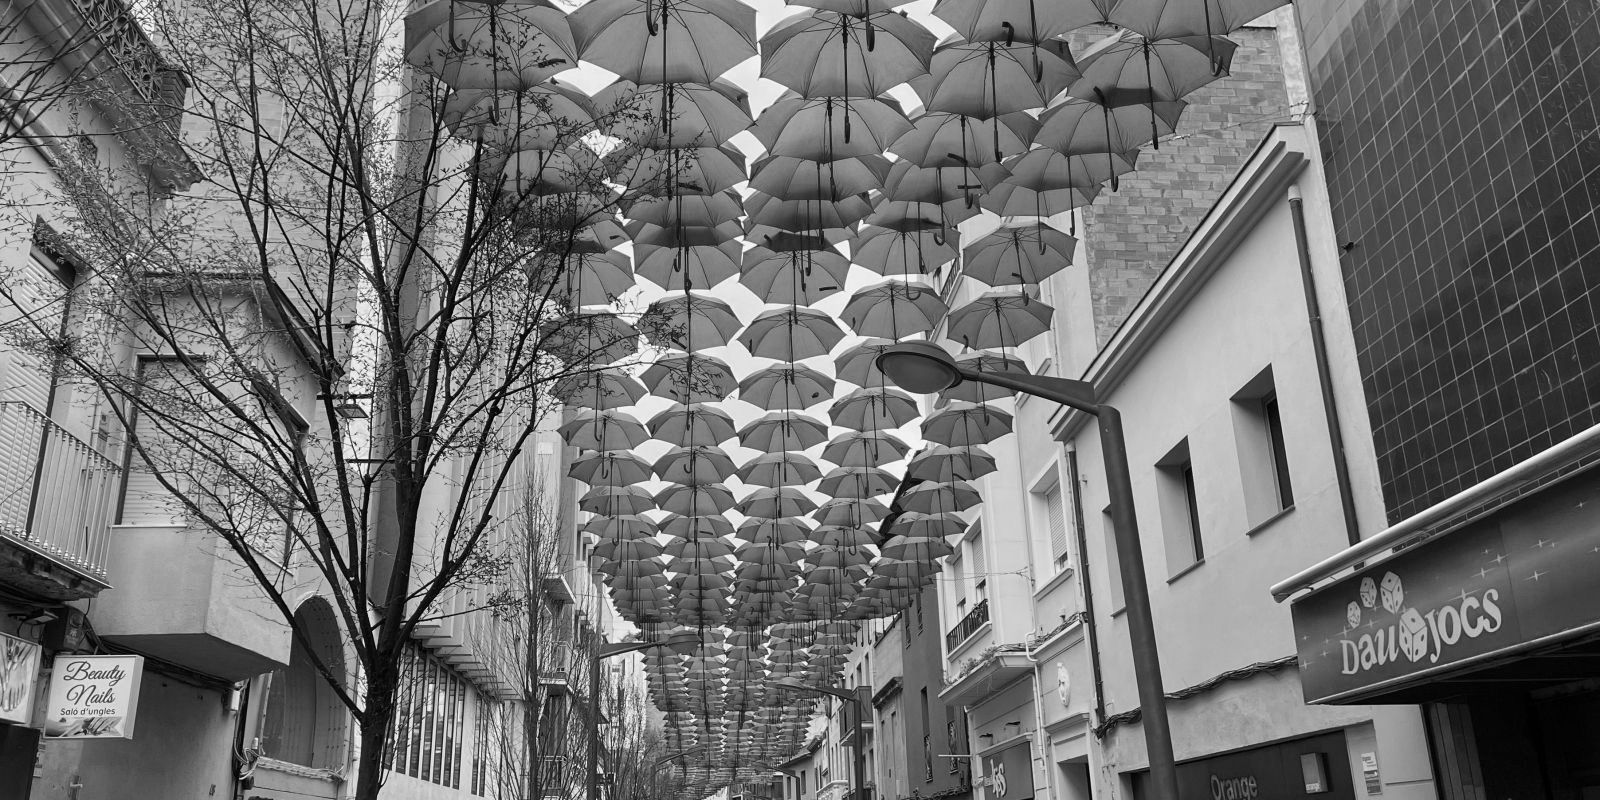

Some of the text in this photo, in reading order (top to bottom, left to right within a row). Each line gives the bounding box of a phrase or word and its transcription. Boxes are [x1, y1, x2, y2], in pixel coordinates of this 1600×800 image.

[63, 660, 126, 687] Beauty
[66, 684, 116, 707] Nails
[60, 707, 116, 717] Saló d'ungles
[1210, 774, 1258, 800] Orange
